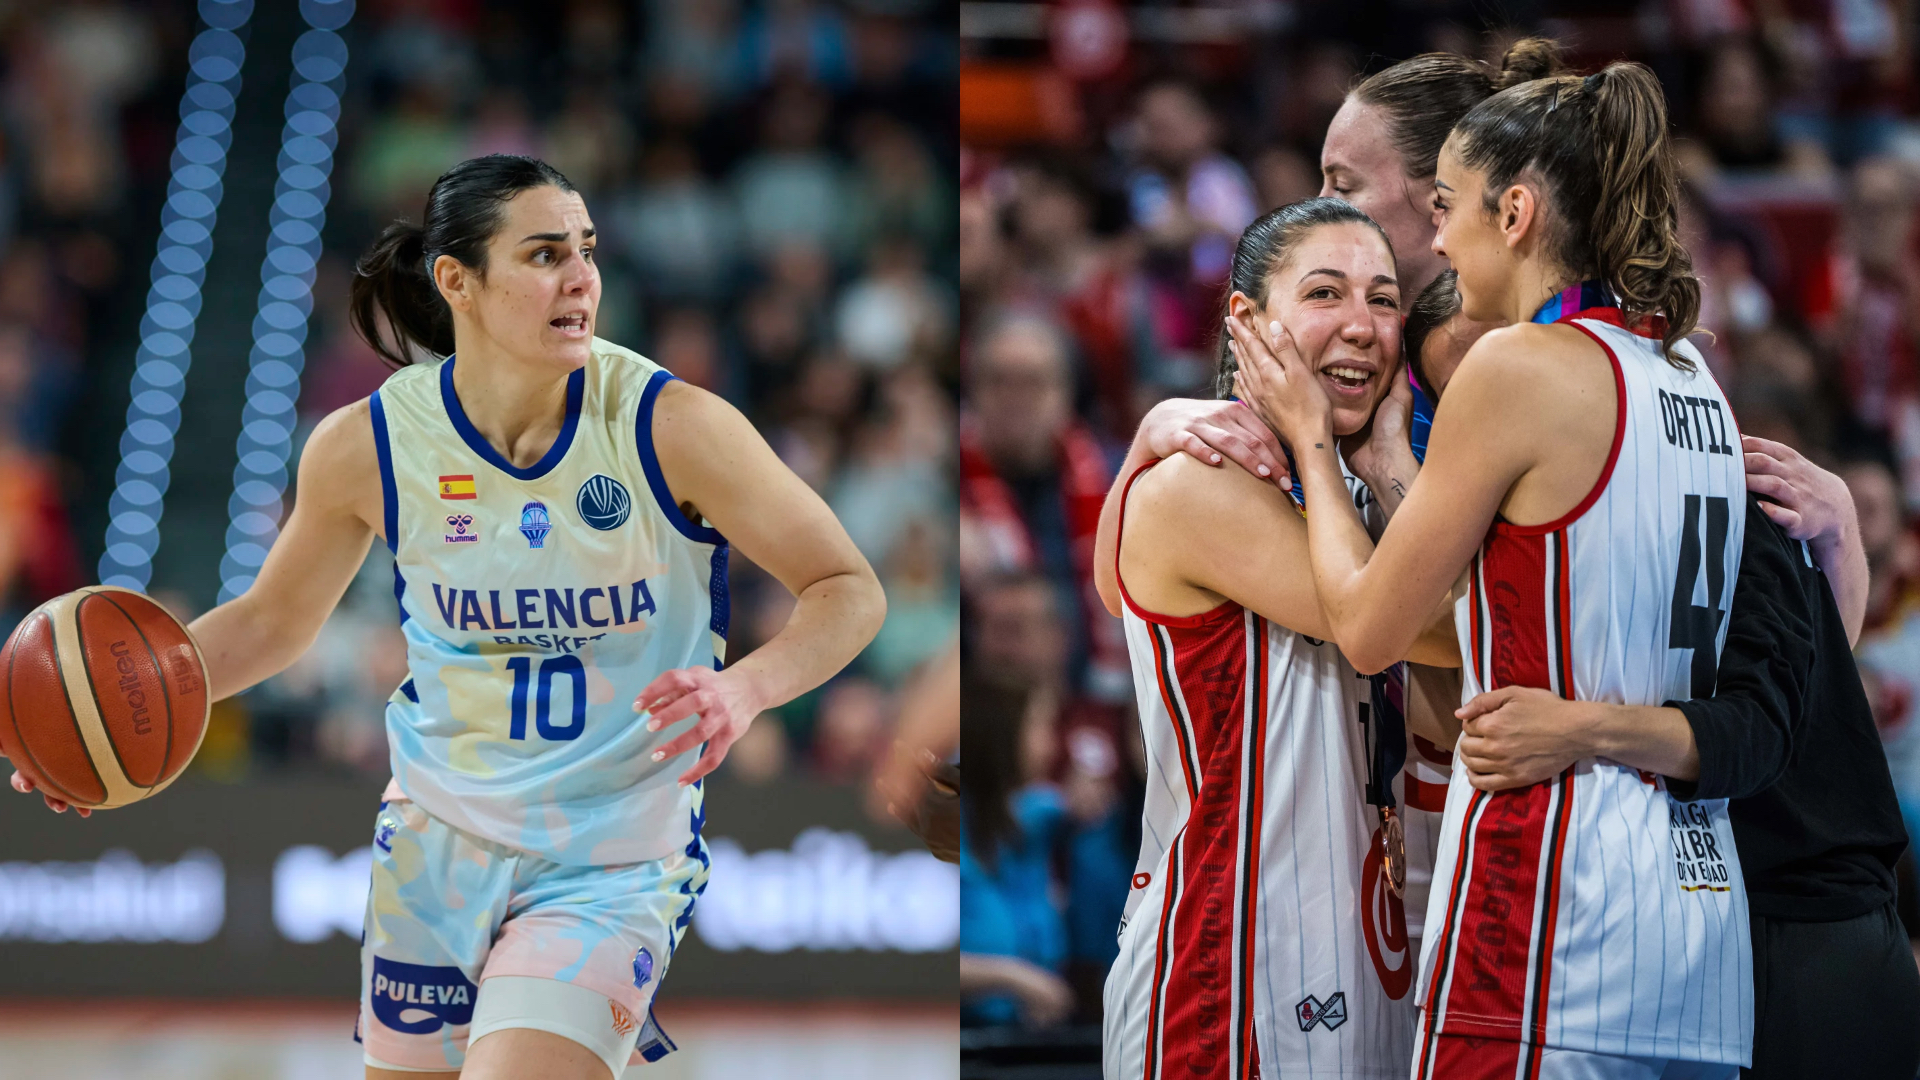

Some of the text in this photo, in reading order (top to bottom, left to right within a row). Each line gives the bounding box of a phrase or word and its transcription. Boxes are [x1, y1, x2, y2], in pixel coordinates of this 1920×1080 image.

[1658, 387, 1734, 457] ORTIZ
[445, 533, 478, 543] hummel
[432, 578, 657, 631] VALENCIA
[1669, 494, 1730, 700] 4
[110, 641, 152, 736] molten
[505, 654, 587, 742] 10
[375, 973, 470, 1005] PULEVA
